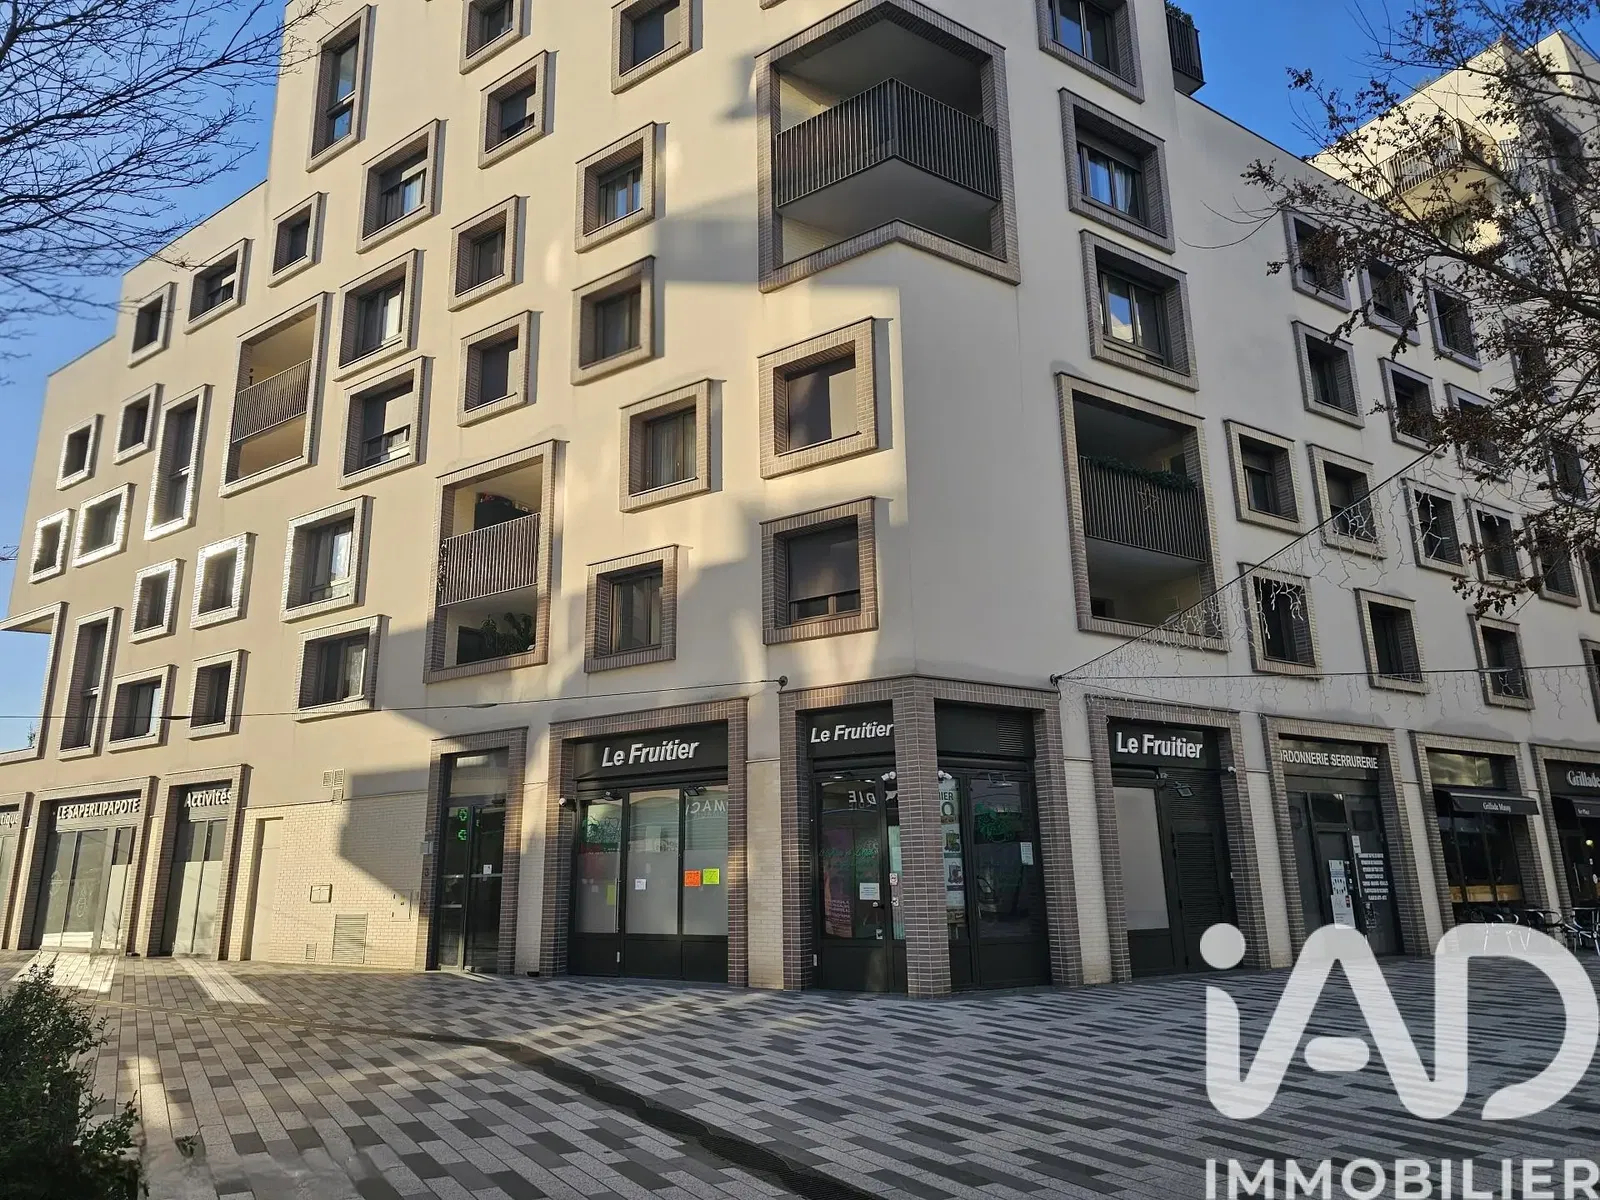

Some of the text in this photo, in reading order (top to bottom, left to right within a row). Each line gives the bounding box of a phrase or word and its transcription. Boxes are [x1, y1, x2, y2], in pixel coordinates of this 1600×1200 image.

[809, 721, 894, 744] Le Fruitier
[601, 739, 700, 767] Le Fruitier
[1115, 731, 1203, 759] Le Fruitier
[1280, 749, 1379, 769] RDONNERIE SERRURERIE
[183, 788, 232, 808] Activités
